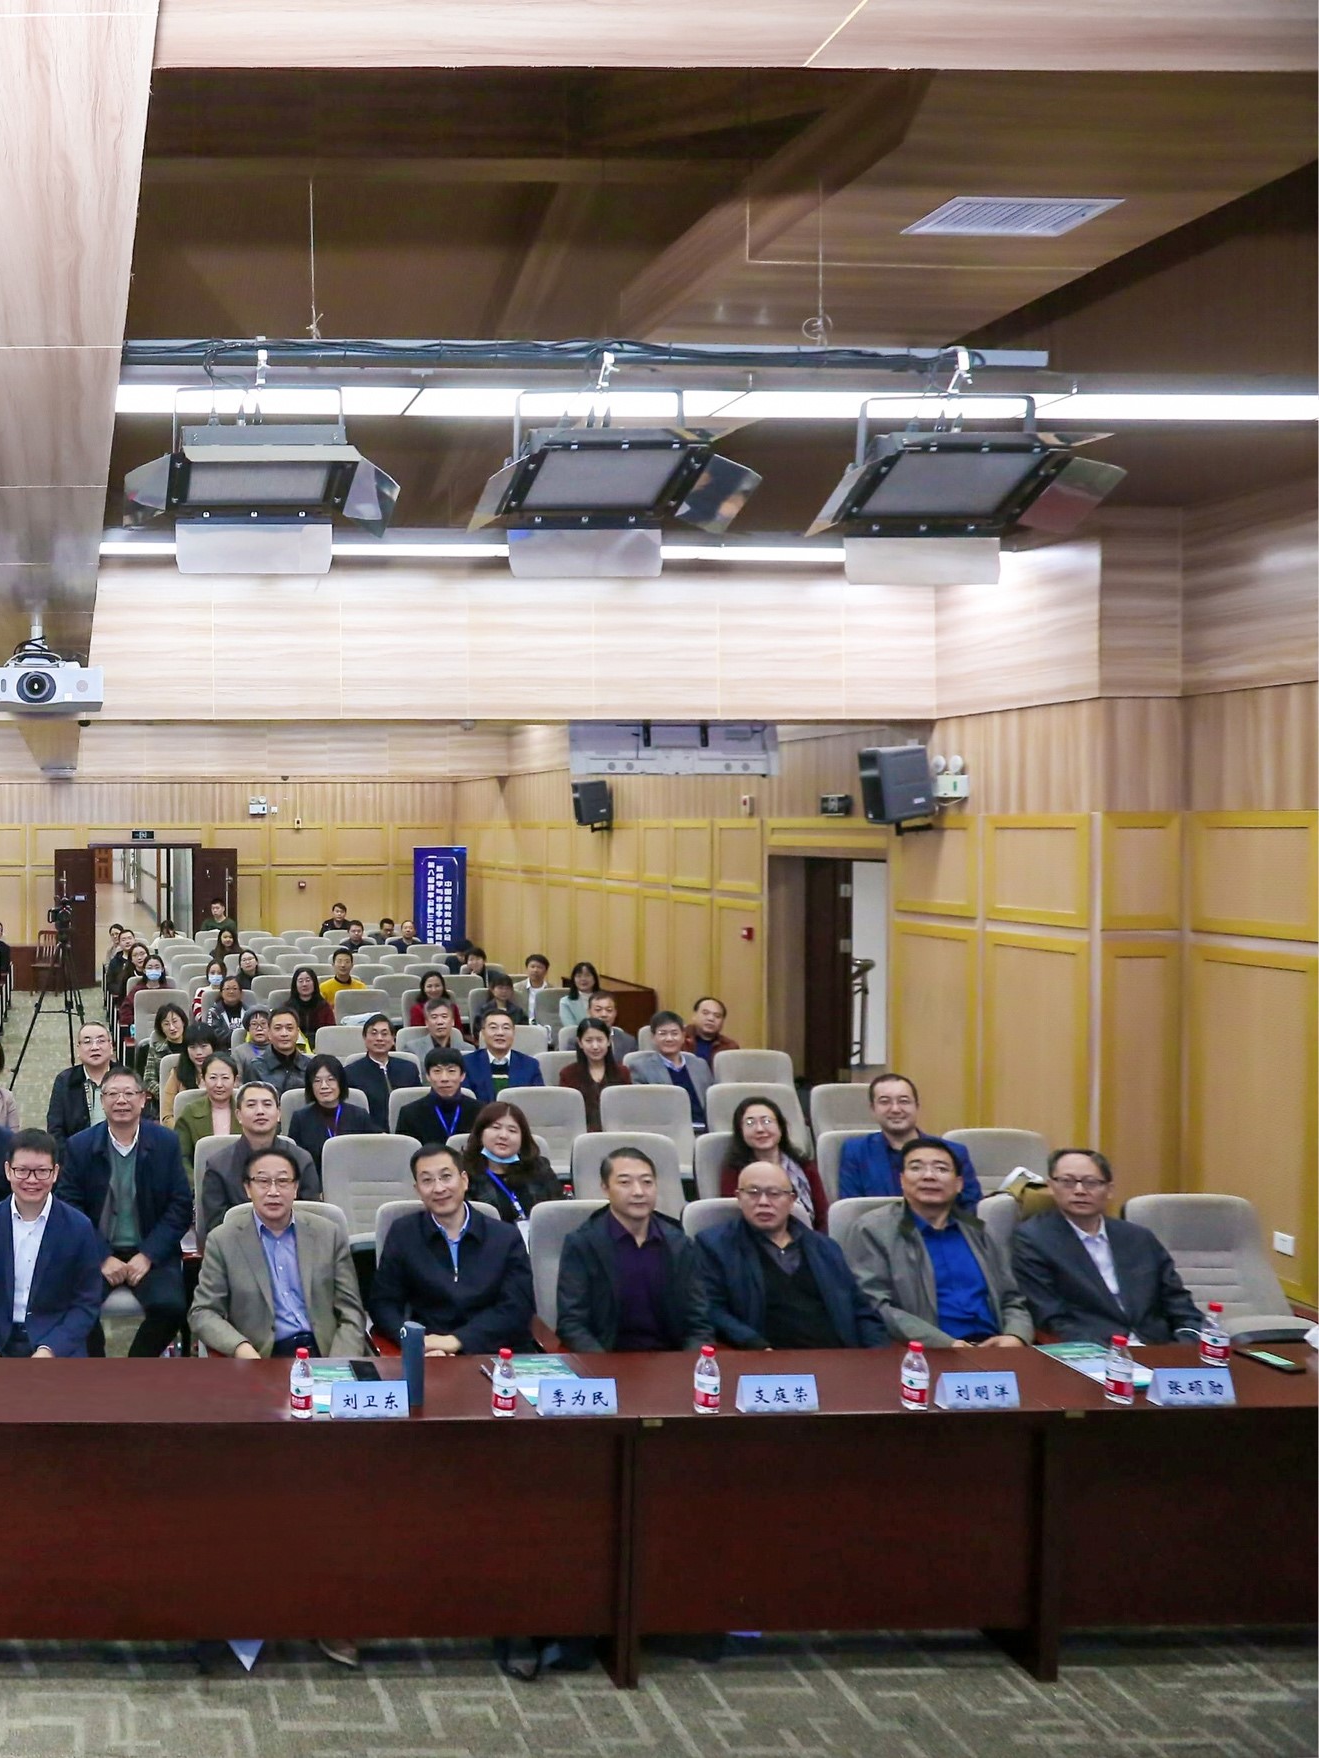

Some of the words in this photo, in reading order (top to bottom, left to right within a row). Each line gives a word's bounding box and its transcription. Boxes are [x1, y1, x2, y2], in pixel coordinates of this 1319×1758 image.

[342, 1390, 400, 1410] 刘卫东
[550, 1388, 610, 1408] 季为民
[754, 1386, 808, 1404] 支庭荣
